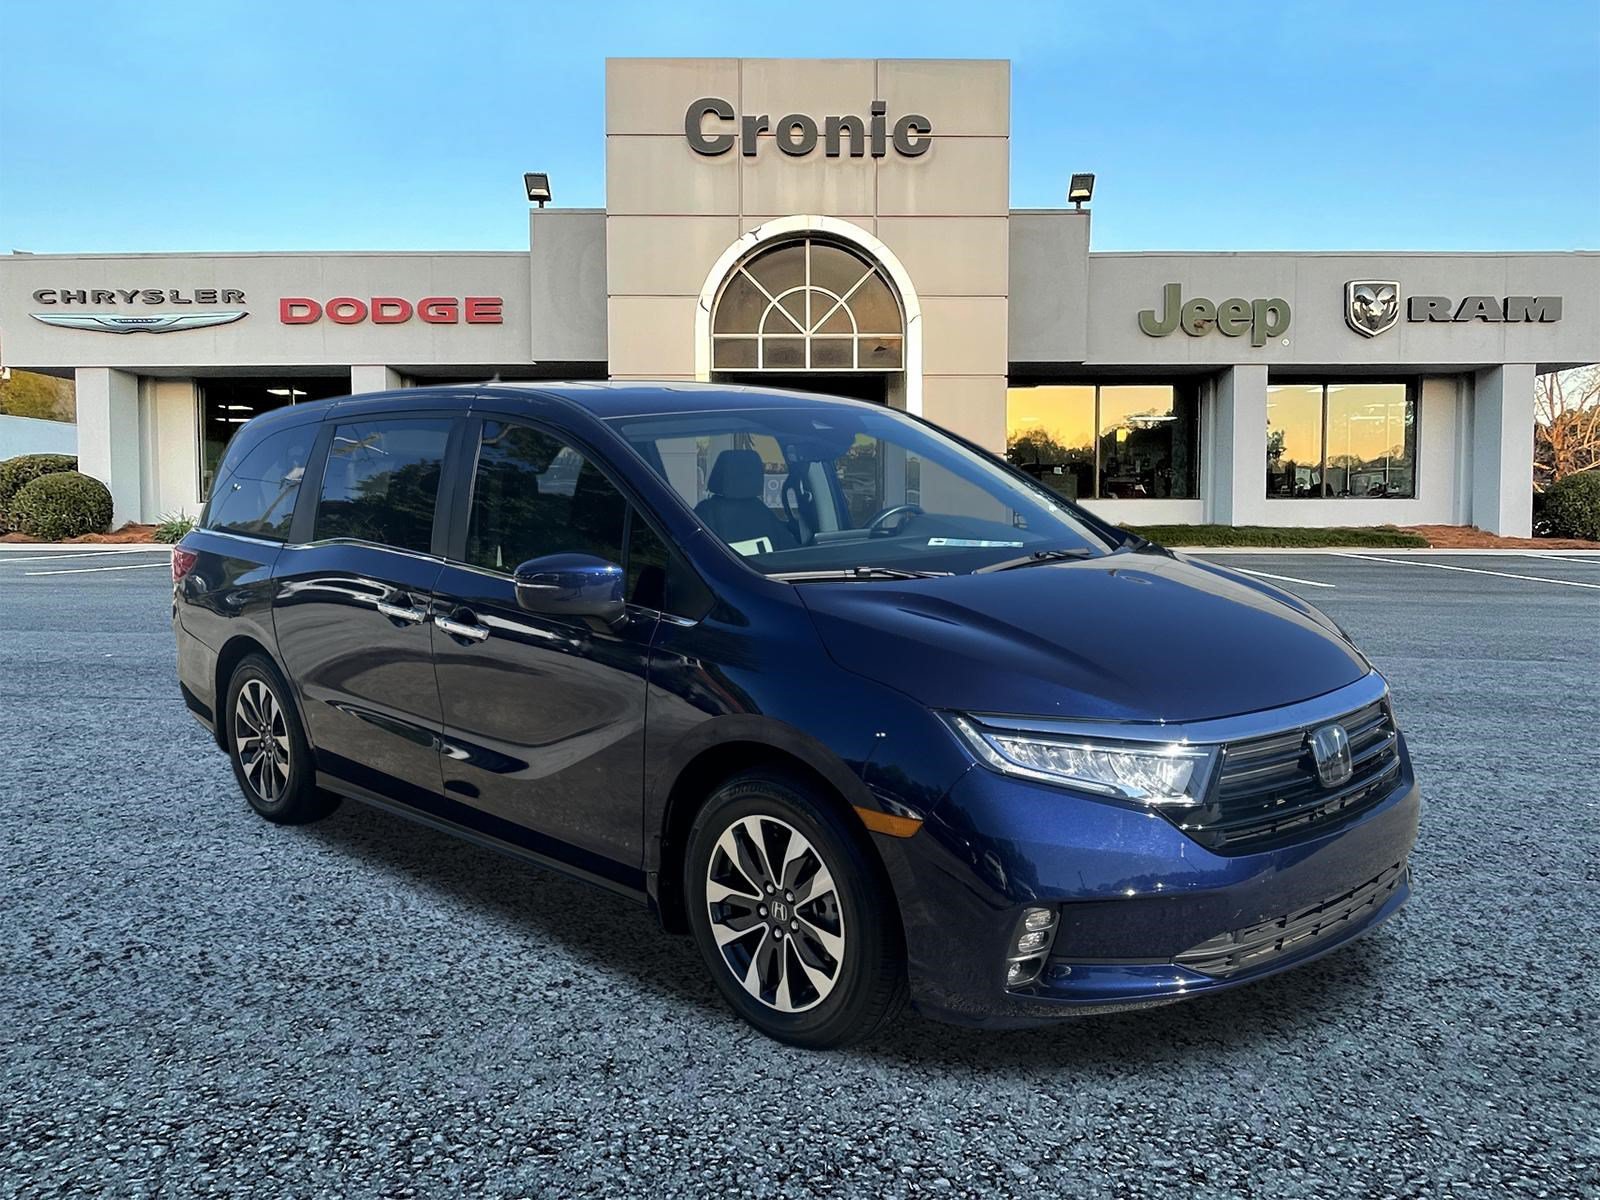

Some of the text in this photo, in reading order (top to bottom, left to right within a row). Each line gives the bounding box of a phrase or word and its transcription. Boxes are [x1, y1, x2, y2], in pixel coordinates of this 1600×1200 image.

[685, 98, 931, 157] Cronic
[32, 289, 246, 304] CHRYSLER
[1407, 296, 1562, 322] RAM
[280, 297, 503, 324] DODGE
[1138, 283, 1291, 347] Jeep
